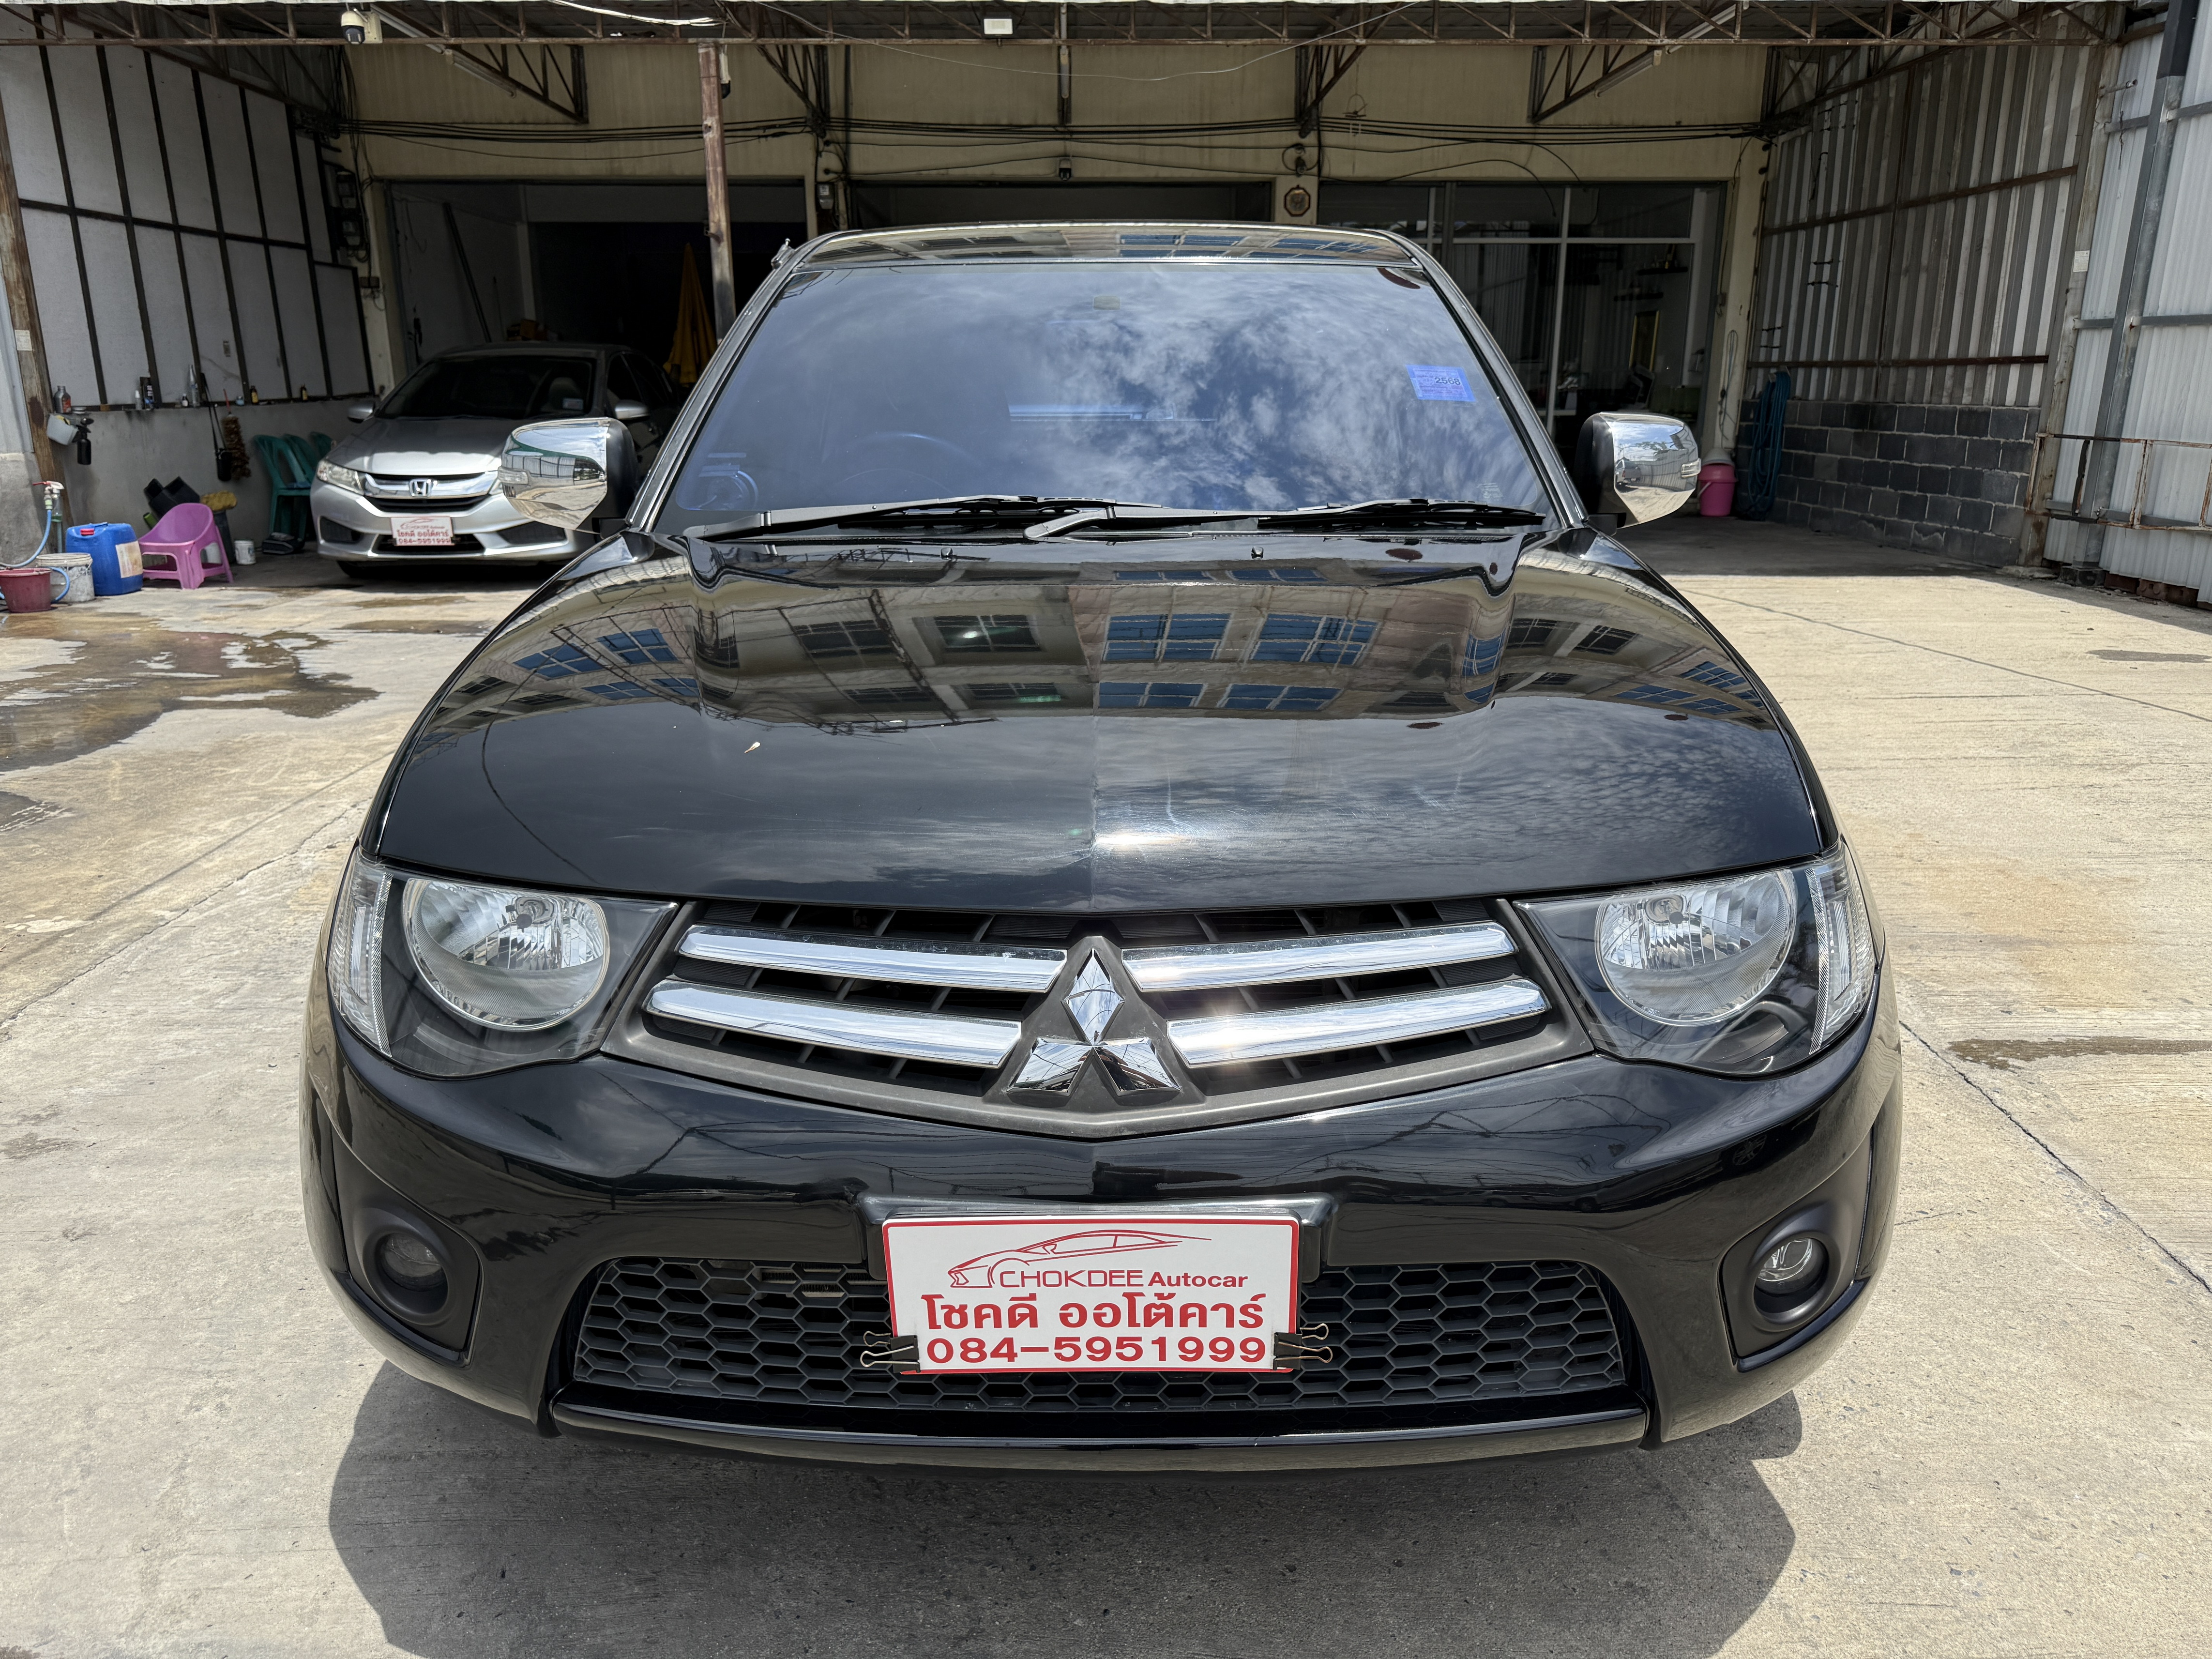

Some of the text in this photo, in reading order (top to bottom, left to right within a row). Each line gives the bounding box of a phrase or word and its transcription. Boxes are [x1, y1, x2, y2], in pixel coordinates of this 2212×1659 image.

[1434, 377, 1461, 385] 2568
[1000, 1270, 1248, 1288] CHOKDEE Autocar
[921, 1292, 1266, 1330] โชคดี ออโต้คาร์
[927, 1336, 1266, 1364] 084-5951999
